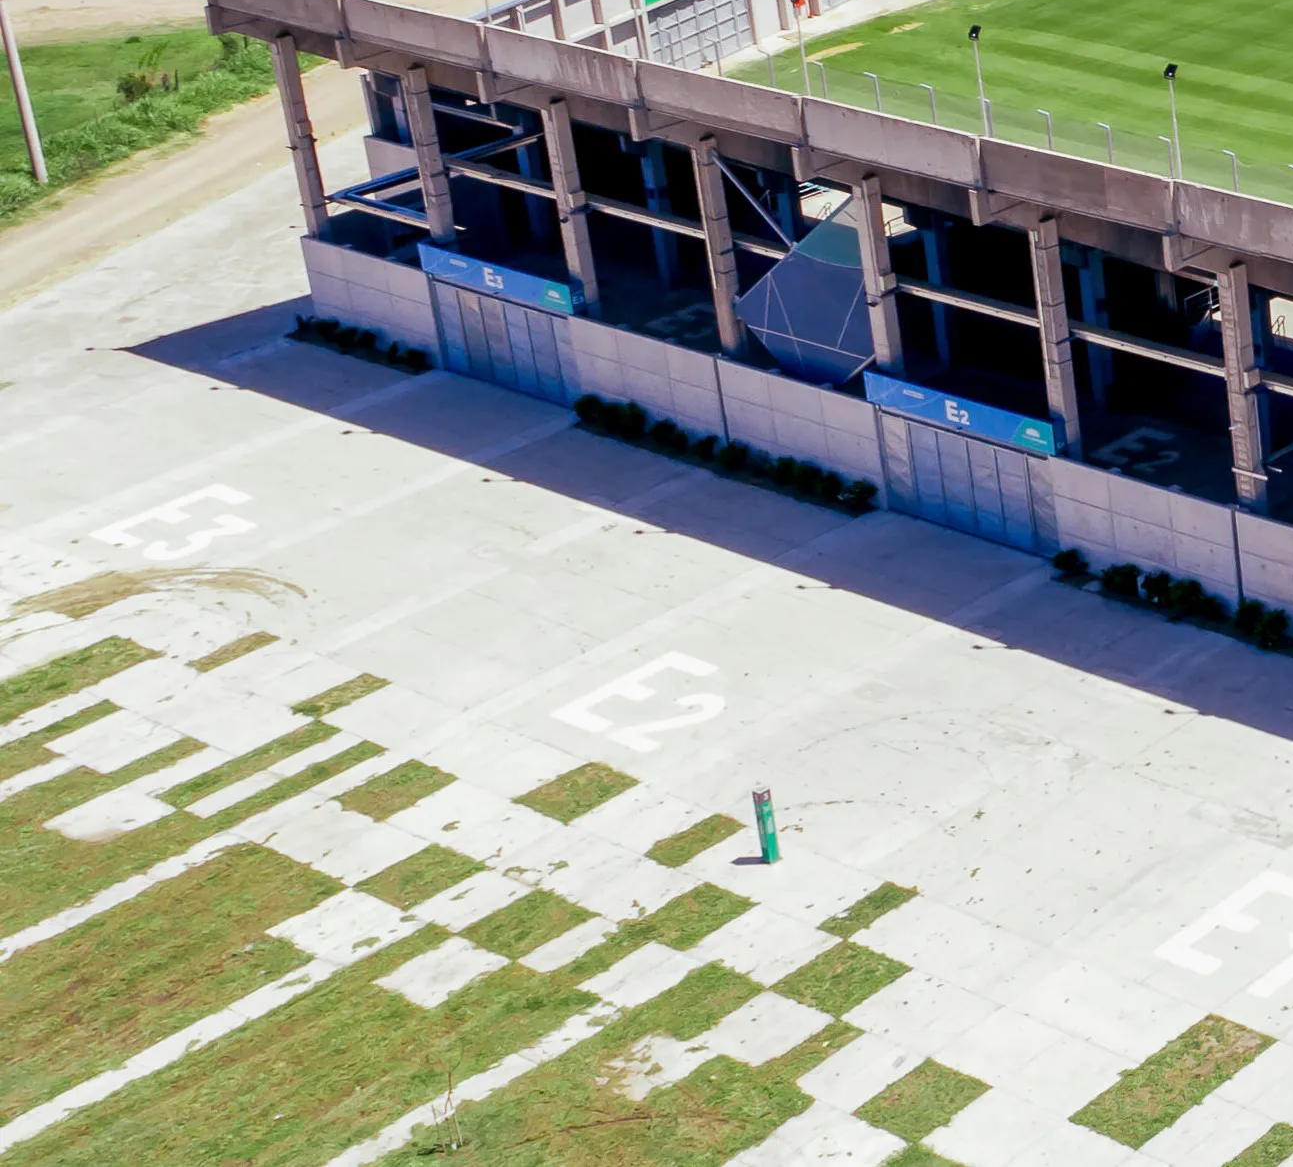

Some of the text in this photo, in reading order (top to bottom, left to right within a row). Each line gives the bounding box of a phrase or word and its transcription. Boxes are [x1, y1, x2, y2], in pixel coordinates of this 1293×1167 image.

[944, 399, 972, 426] E2
[88, 483, 259, 561] E3
[550, 650, 727, 753] E2
